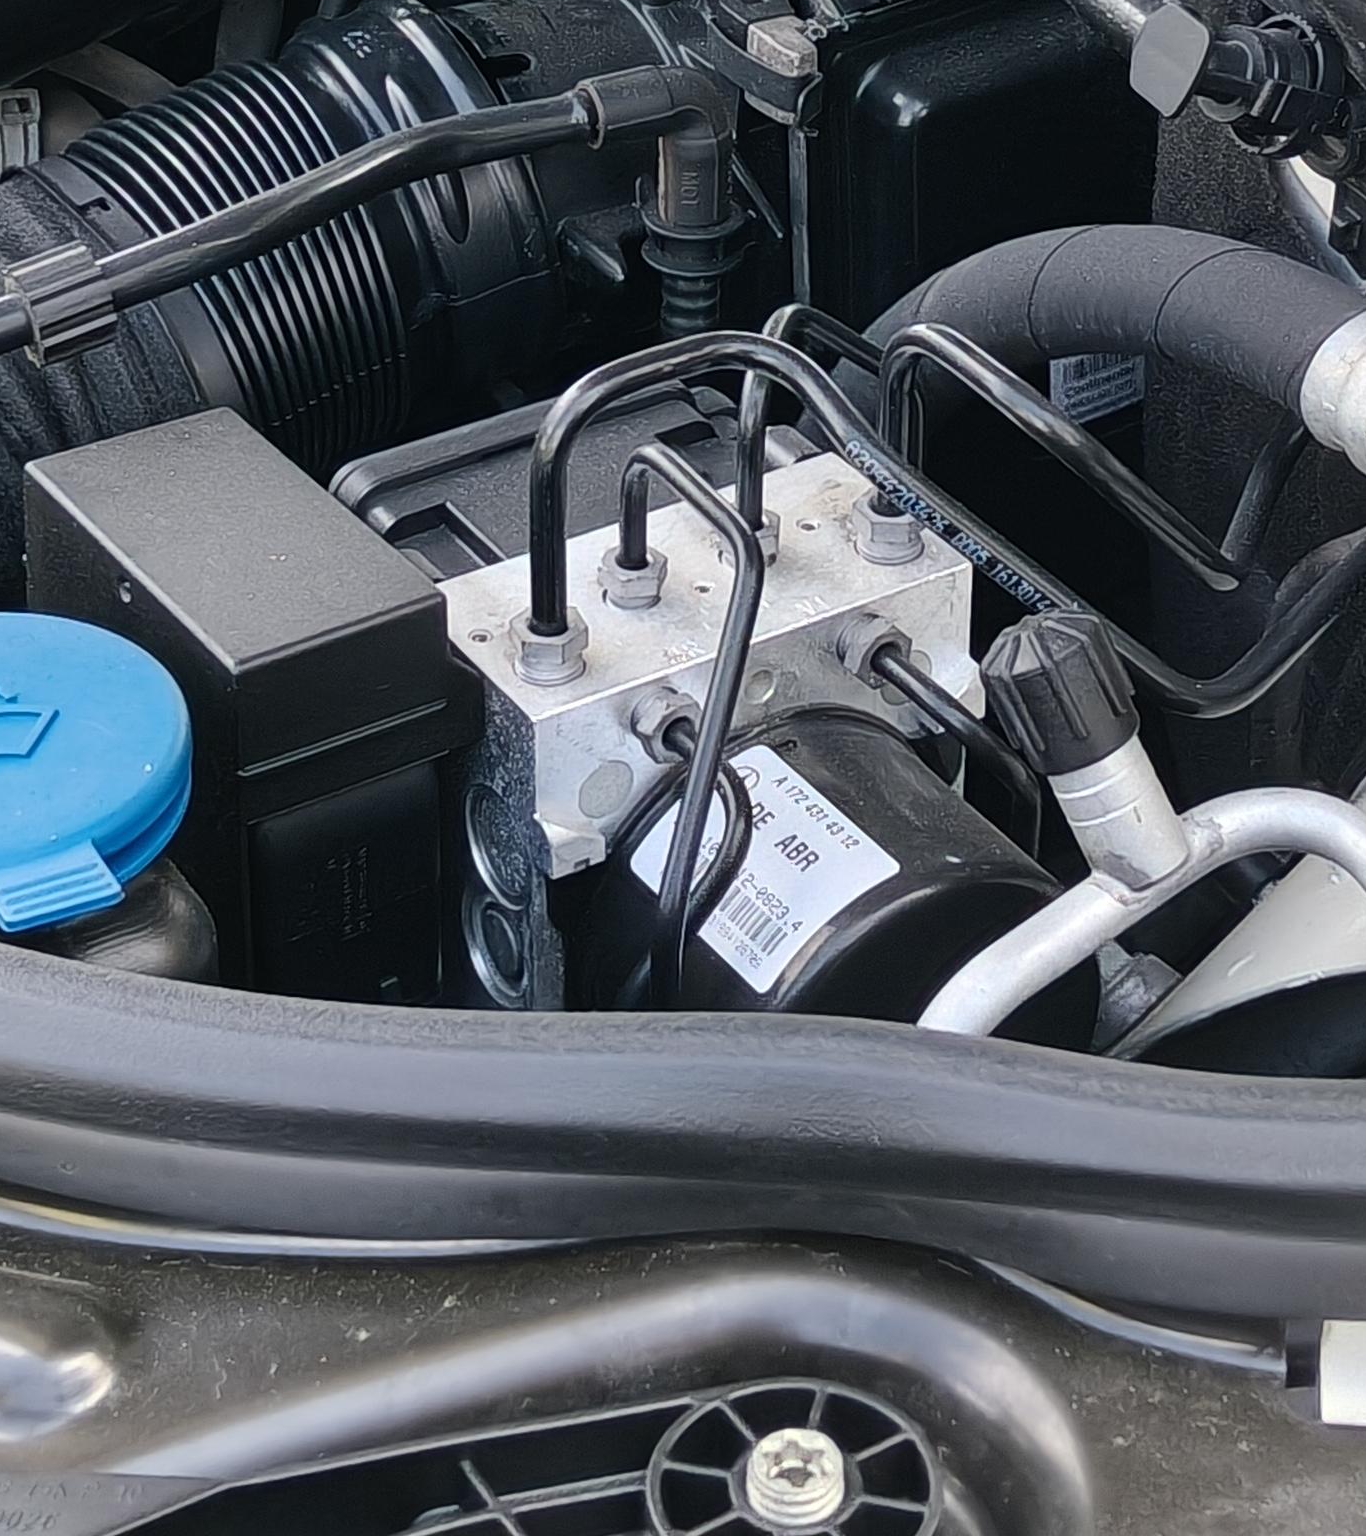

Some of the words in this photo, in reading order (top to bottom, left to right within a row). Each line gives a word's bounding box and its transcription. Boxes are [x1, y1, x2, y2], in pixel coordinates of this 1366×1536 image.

[771, 775, 789, 791] A
[784, 784, 810, 806] 172
[773, 833, 821, 872] ABR
